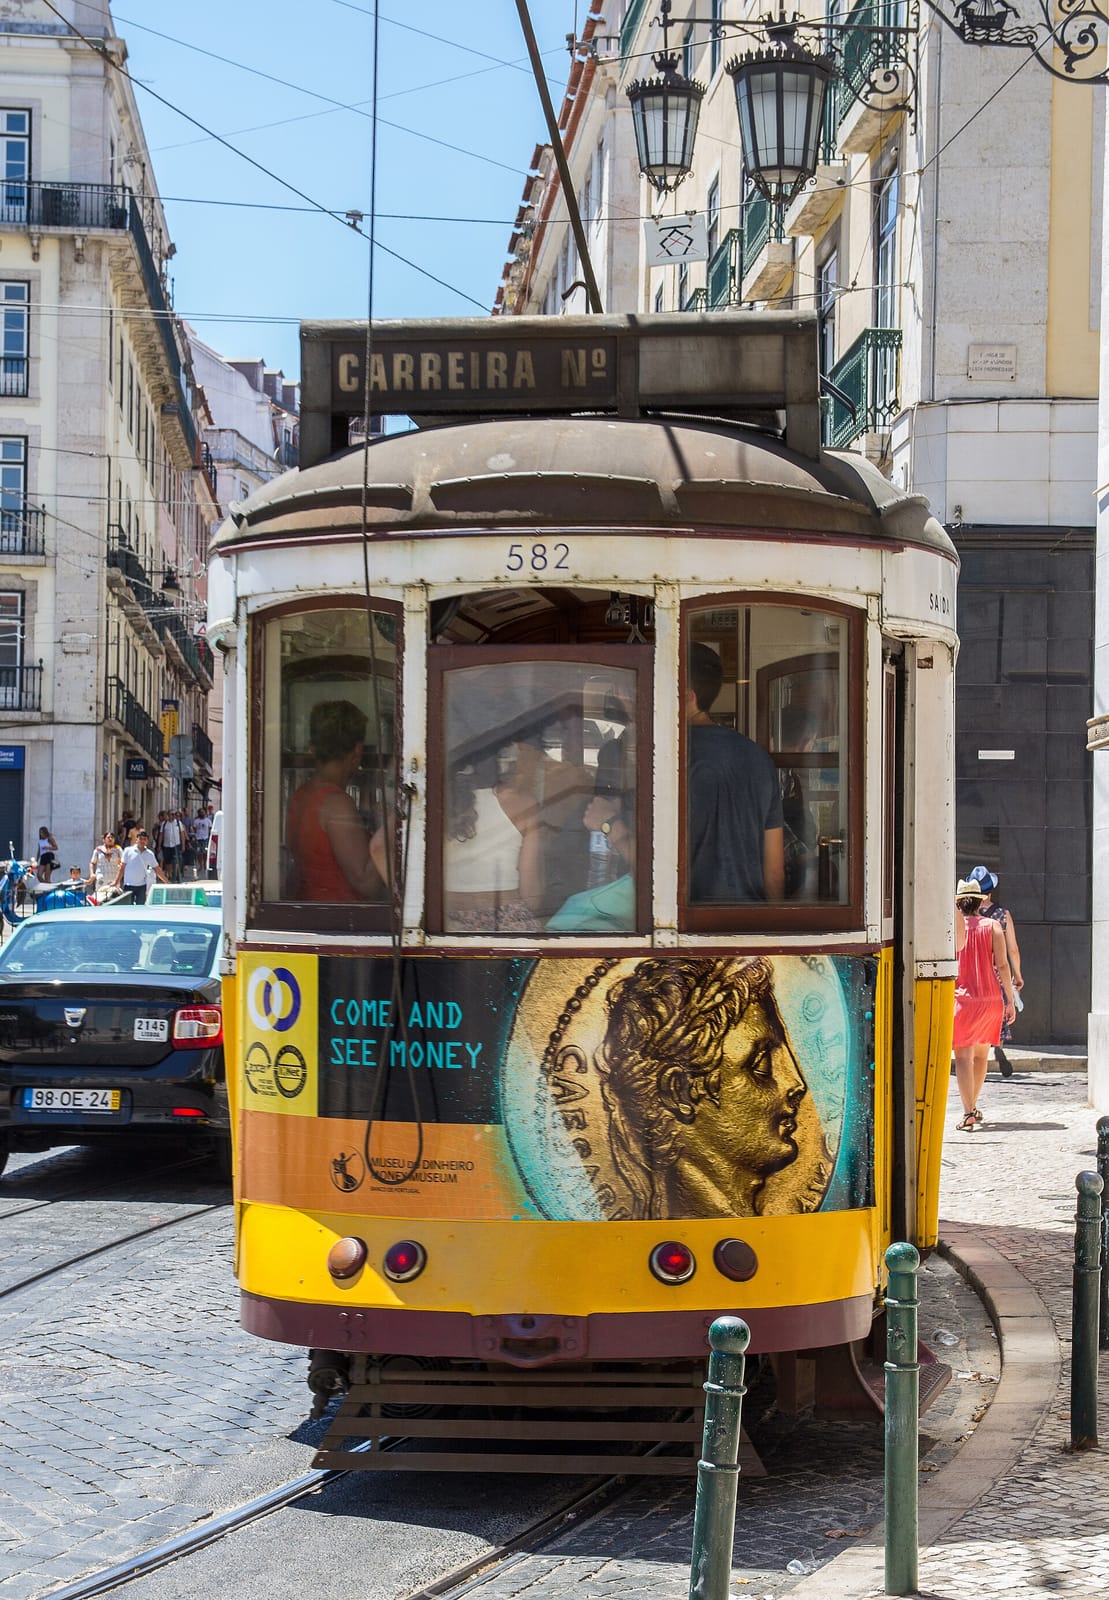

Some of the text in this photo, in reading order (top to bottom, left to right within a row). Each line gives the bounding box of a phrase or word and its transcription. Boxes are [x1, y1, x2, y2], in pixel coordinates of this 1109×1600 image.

[338, 350, 536, 391] CARREIRA
[507, 543, 569, 571] 582
[137, 1020, 165, 1031] 2145
[330, 999, 463, 1028] COME AND
[330, 1038, 483, 1069] SEE MONEY
[371, 1157, 405, 1169] MUSEU
[423, 1159, 475, 1171] DINHEIRO
[411, 1173, 458, 1183] MUSEUM
